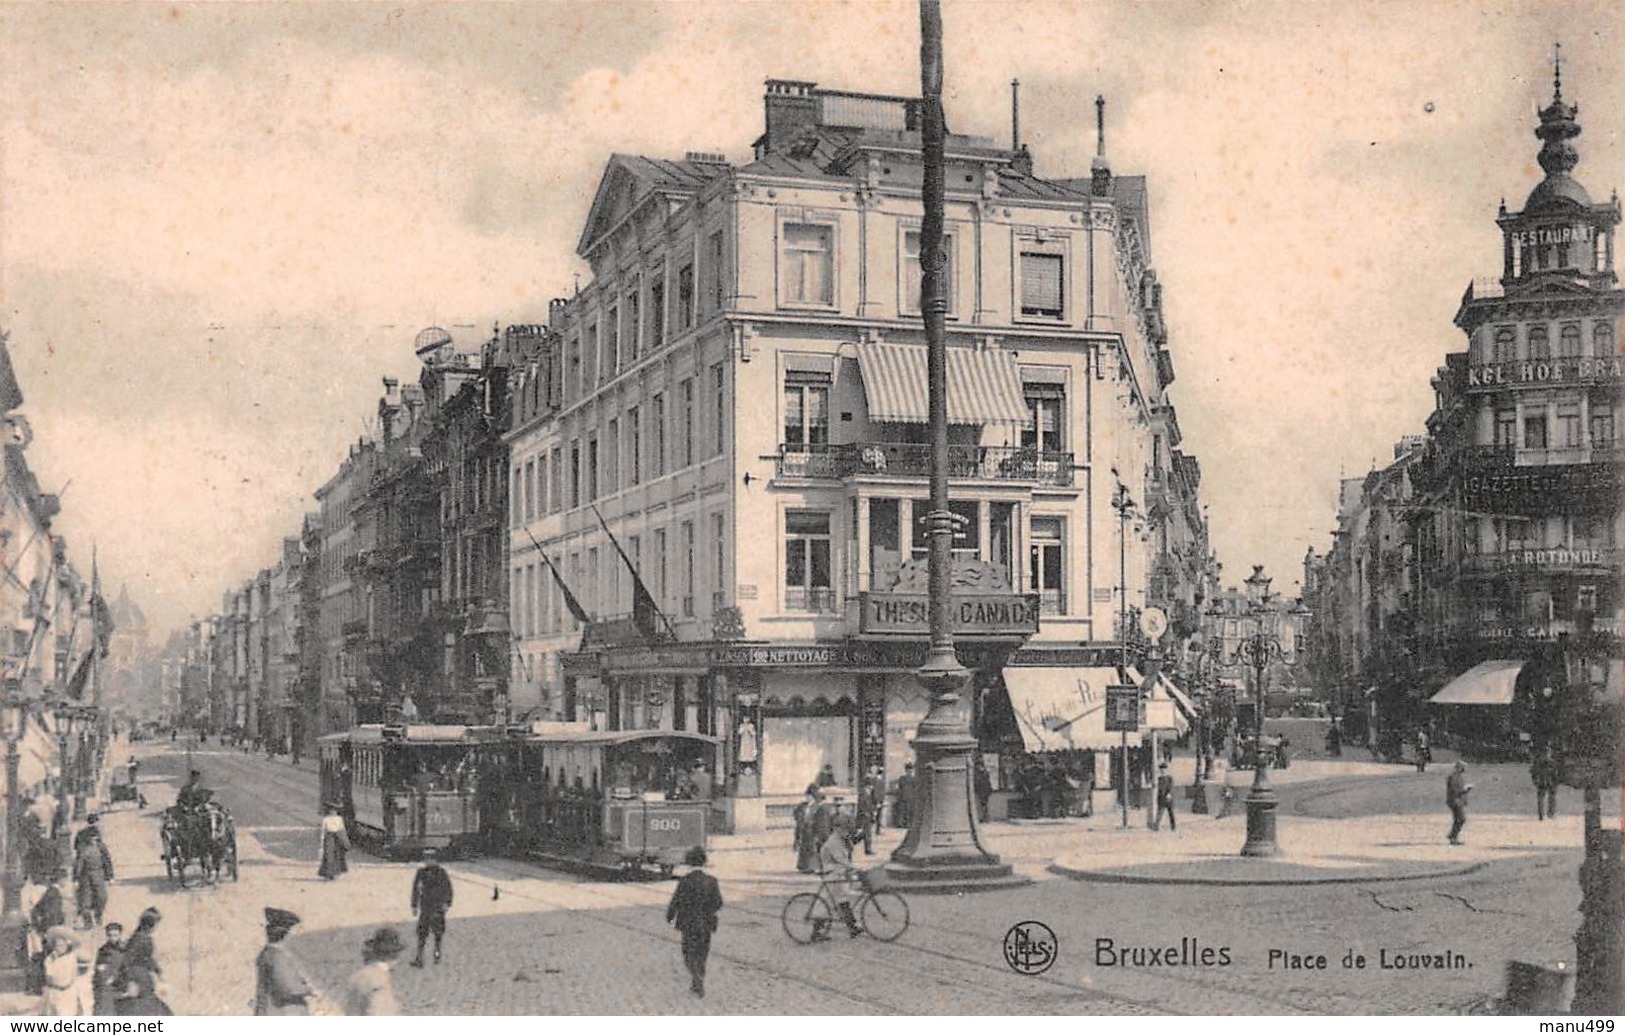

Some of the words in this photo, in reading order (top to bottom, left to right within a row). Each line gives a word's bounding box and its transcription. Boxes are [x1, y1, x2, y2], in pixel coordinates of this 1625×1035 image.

[1511, 226, 1595, 246] RESTAURANT
[1470, 475, 1540, 492] GAZETTE
[1524, 550, 1603, 564] ROTONDE
[769, 649, 835, 663] NETTOYAGE
[650, 819, 680, 831] 900
